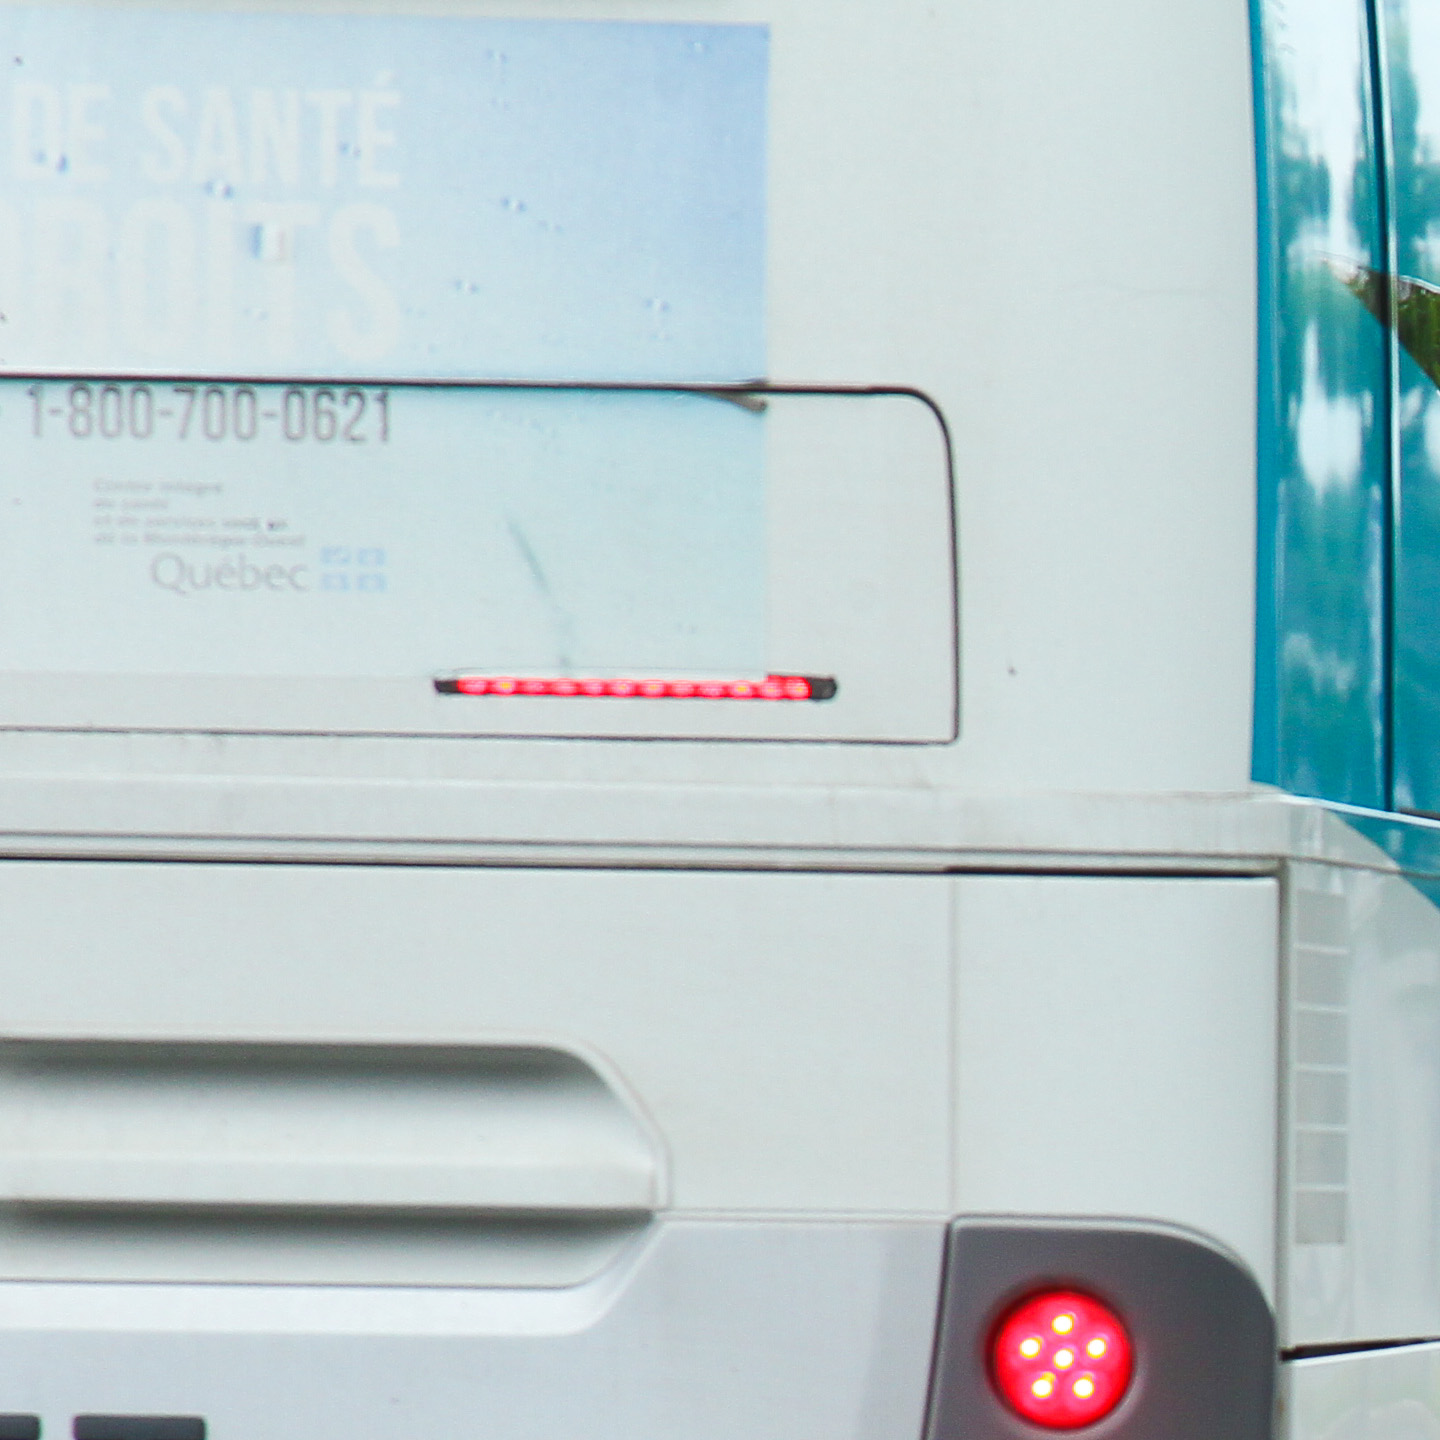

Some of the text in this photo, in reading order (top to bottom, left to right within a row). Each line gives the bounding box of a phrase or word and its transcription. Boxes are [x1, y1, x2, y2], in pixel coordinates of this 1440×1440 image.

[16, 67, 402, 189] DE SANTÉ
[26, 384, 392, 445] 1-800-700-0621
[149, 551, 311, 597] Québec
